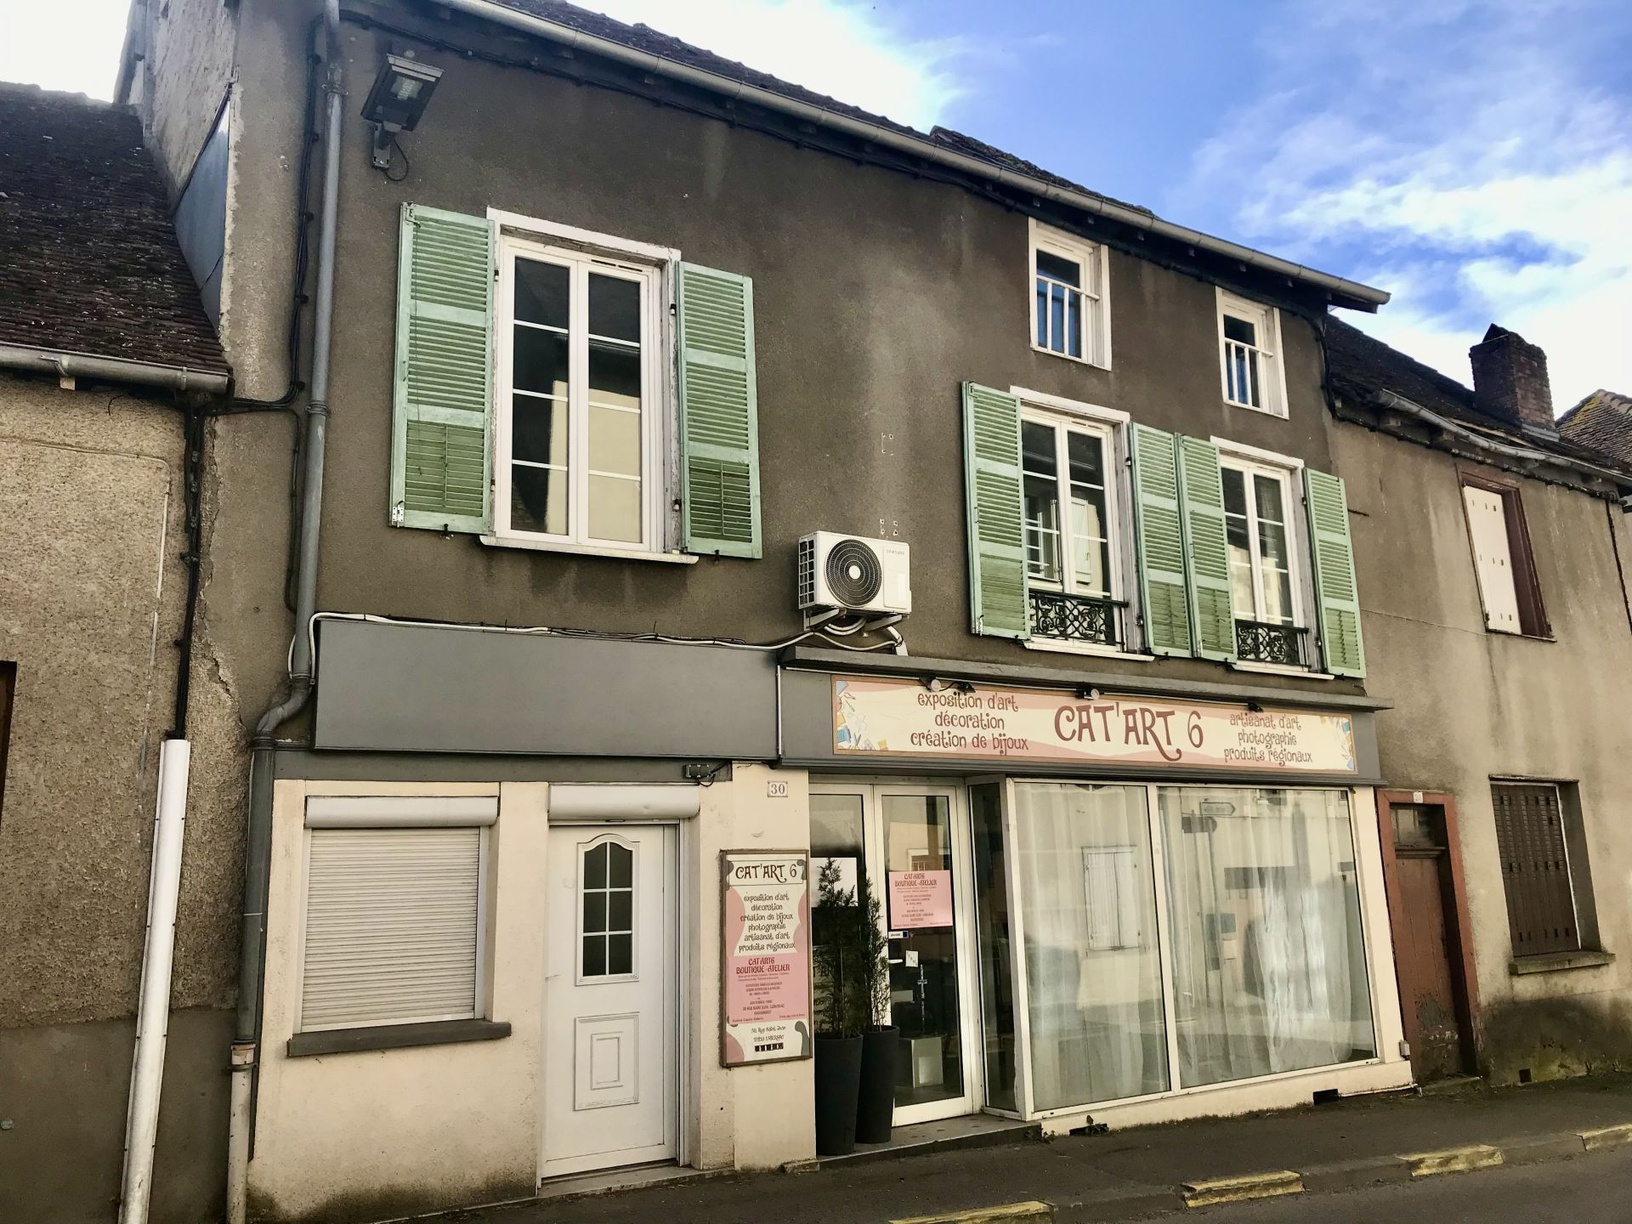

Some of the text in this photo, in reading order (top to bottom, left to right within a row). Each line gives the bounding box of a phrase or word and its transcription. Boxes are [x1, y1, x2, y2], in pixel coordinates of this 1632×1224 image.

[917, 691, 1019, 712] exposition d'art
[934, 711, 1005, 731] décoration
[1229, 713, 1302, 731] artisanat d'art
[1054, 702, 1204, 762] CAT'ART 6
[1238, 731, 1298, 750] photographie
[910, 729, 1029, 756] création de bijoux
[1223, 747, 1313, 767] produits régionaux
[770, 783, 786, 795] 30
[735, 863, 797, 884] CAT'ART 6
[775, 912, 794, 925] bijoux
